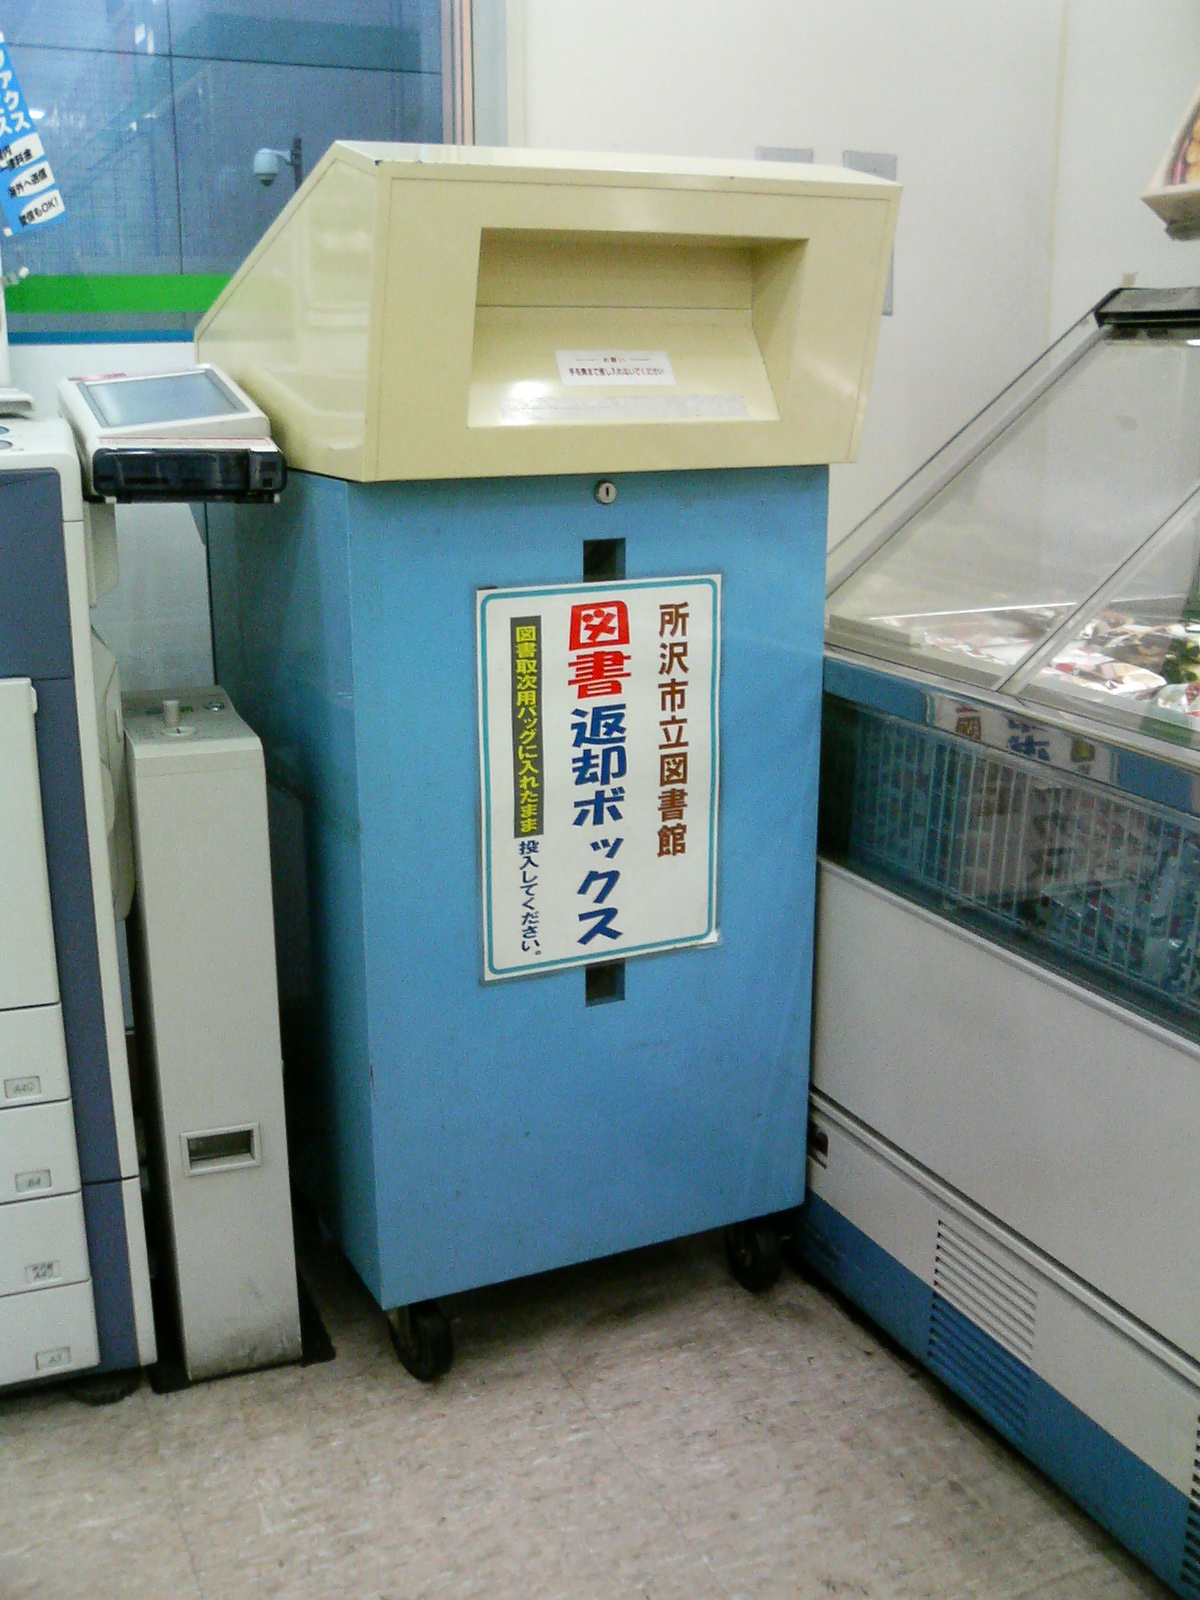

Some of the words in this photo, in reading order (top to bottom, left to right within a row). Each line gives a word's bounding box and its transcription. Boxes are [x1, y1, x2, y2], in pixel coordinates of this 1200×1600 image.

[567, 600, 633, 946] 図書返却ボックス
[657, 601, 691, 857] 所沢市立図書館
